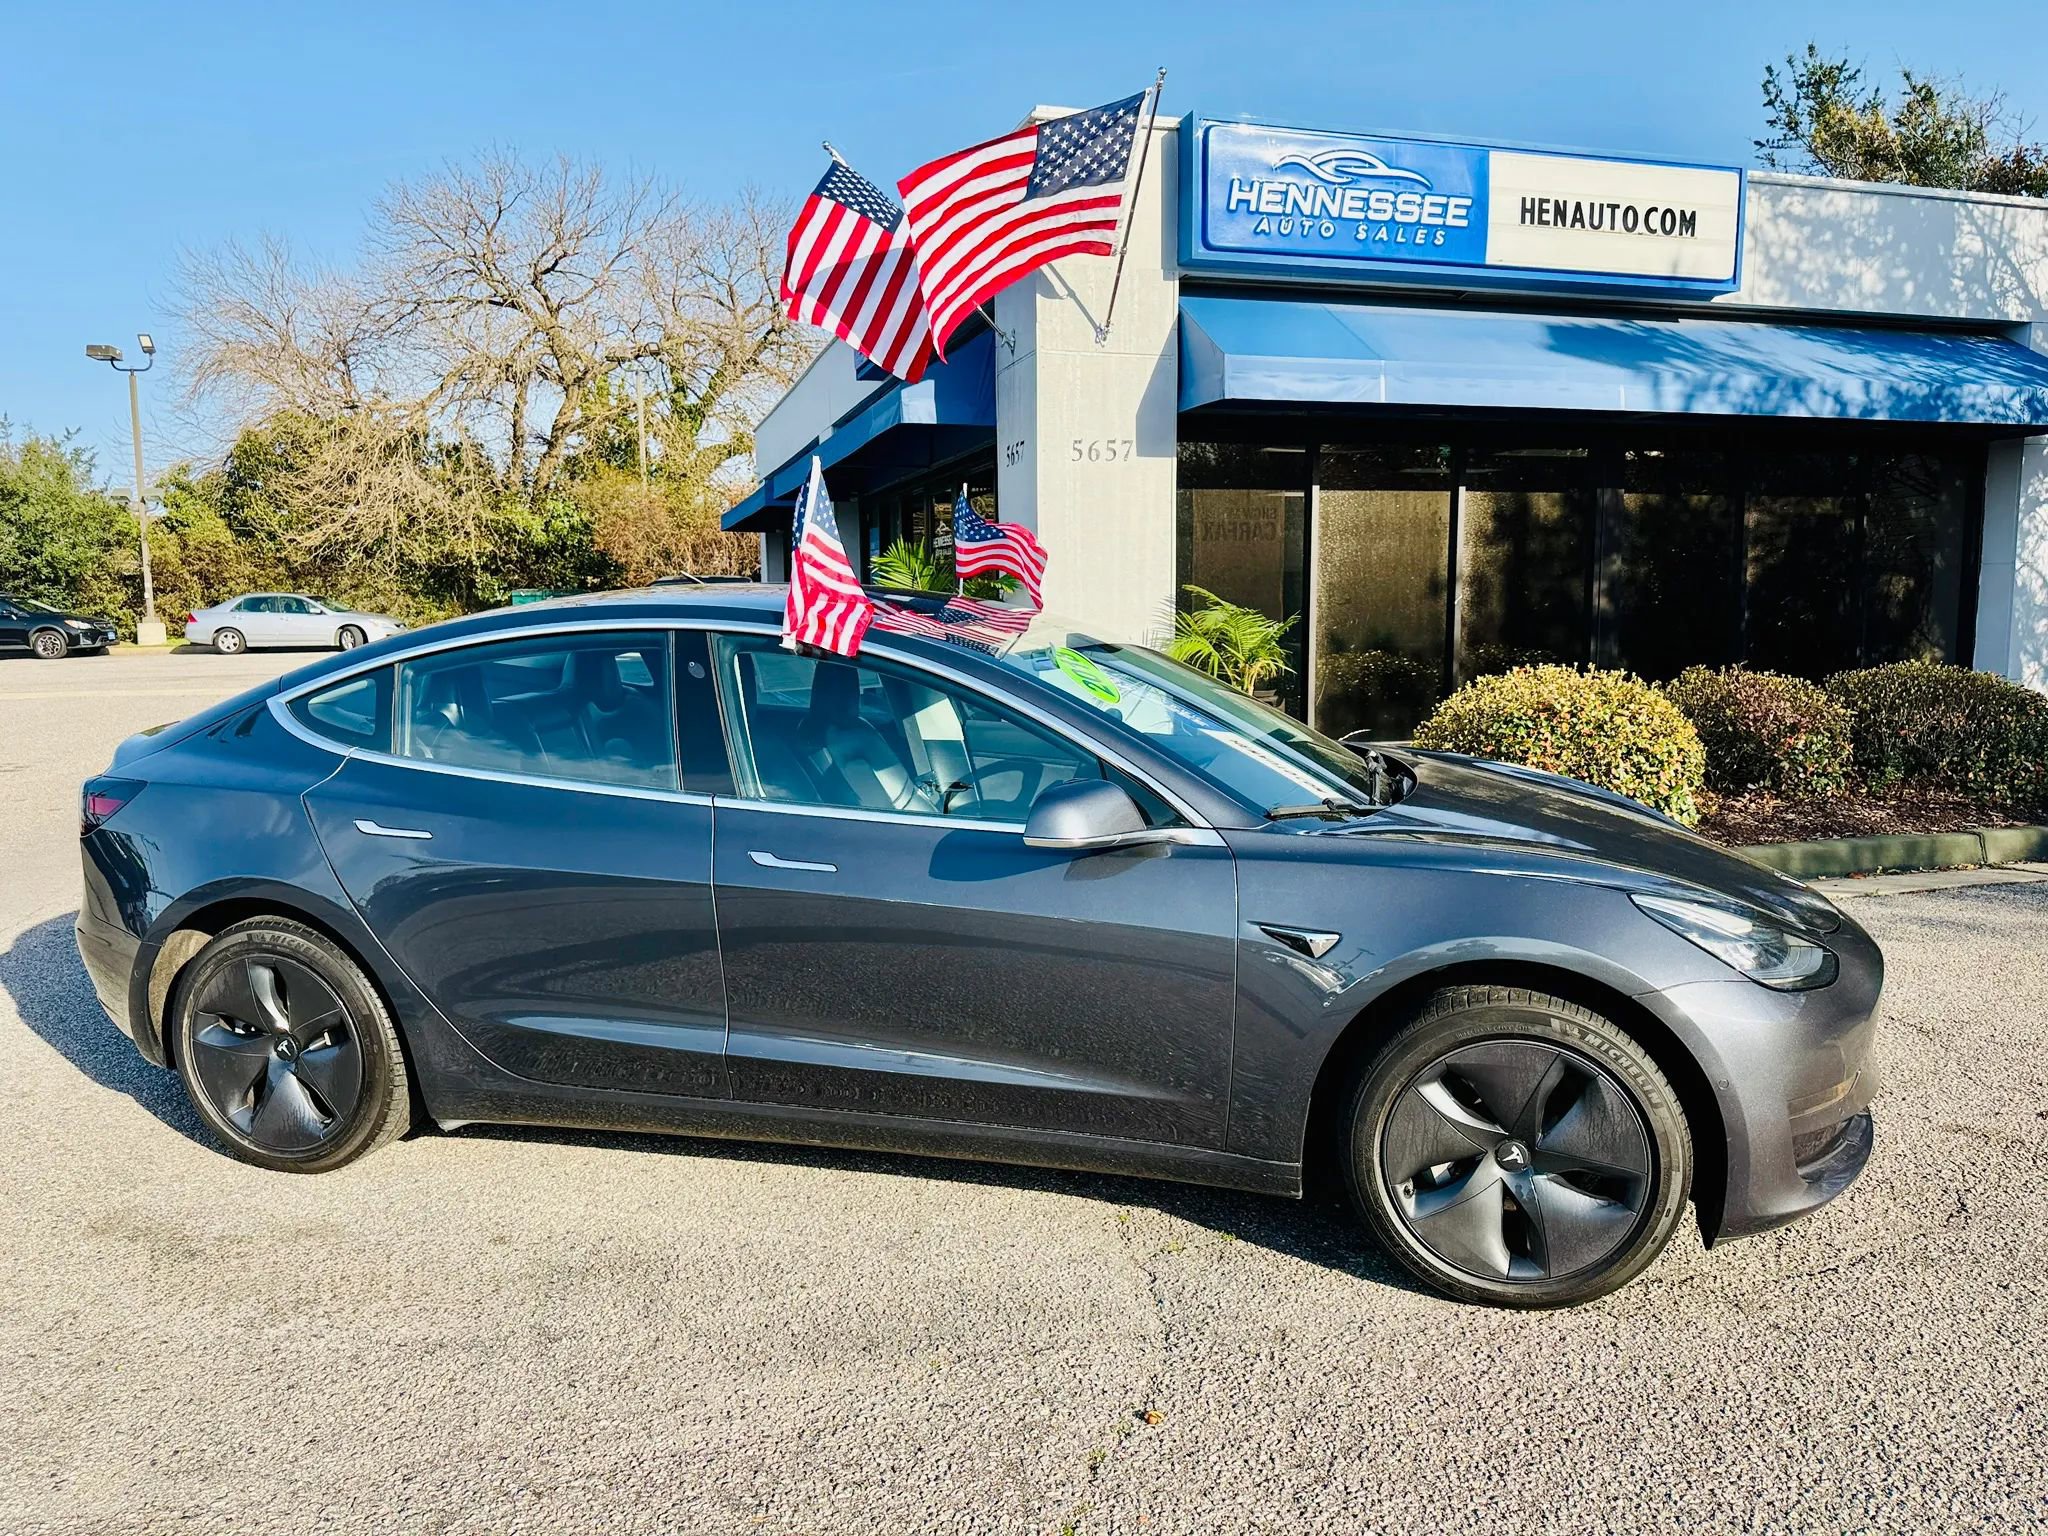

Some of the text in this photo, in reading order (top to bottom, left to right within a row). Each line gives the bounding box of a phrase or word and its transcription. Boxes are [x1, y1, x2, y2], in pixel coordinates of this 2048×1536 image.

[1228, 177, 1473, 228] HENNESSEE
[1256, 216, 1447, 246] AUTO SALES
[1005, 440, 1025, 468] 5657
[1071, 438, 1134, 462] 5657
[269, 933, 333, 967] MICHELI
[1583, 1033, 1663, 1105] MICHELIN
